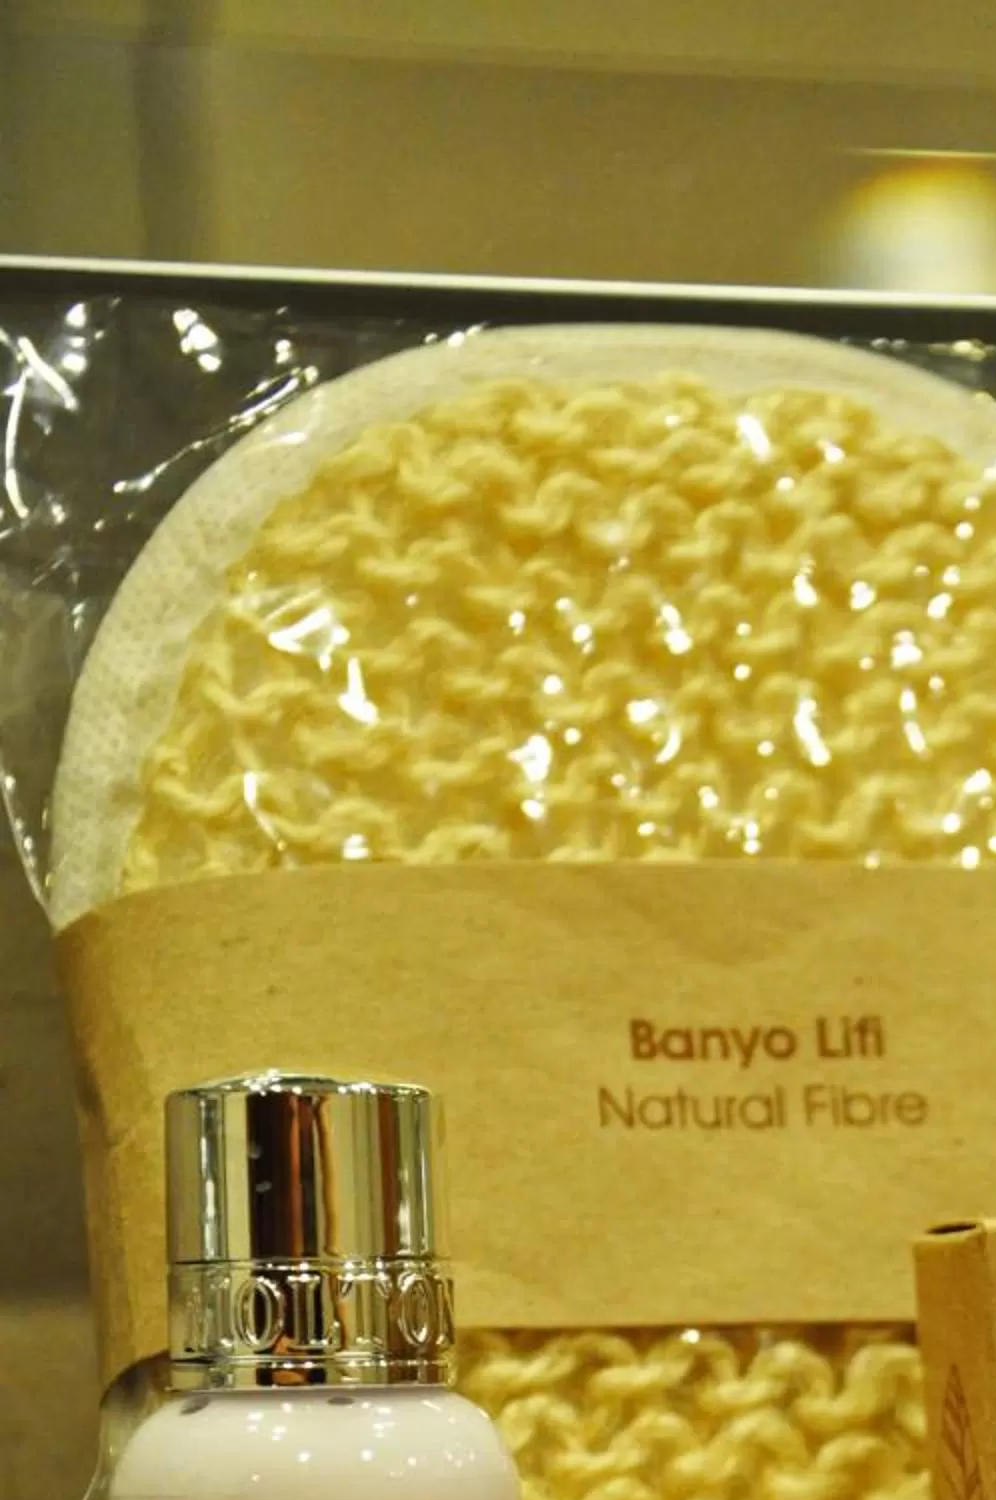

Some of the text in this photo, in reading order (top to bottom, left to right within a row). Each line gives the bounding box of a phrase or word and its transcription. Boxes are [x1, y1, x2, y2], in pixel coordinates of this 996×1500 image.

[629, 1014, 886, 1069] Banyo Lifi
[599, 1083, 928, 1130] Natural Fibre
